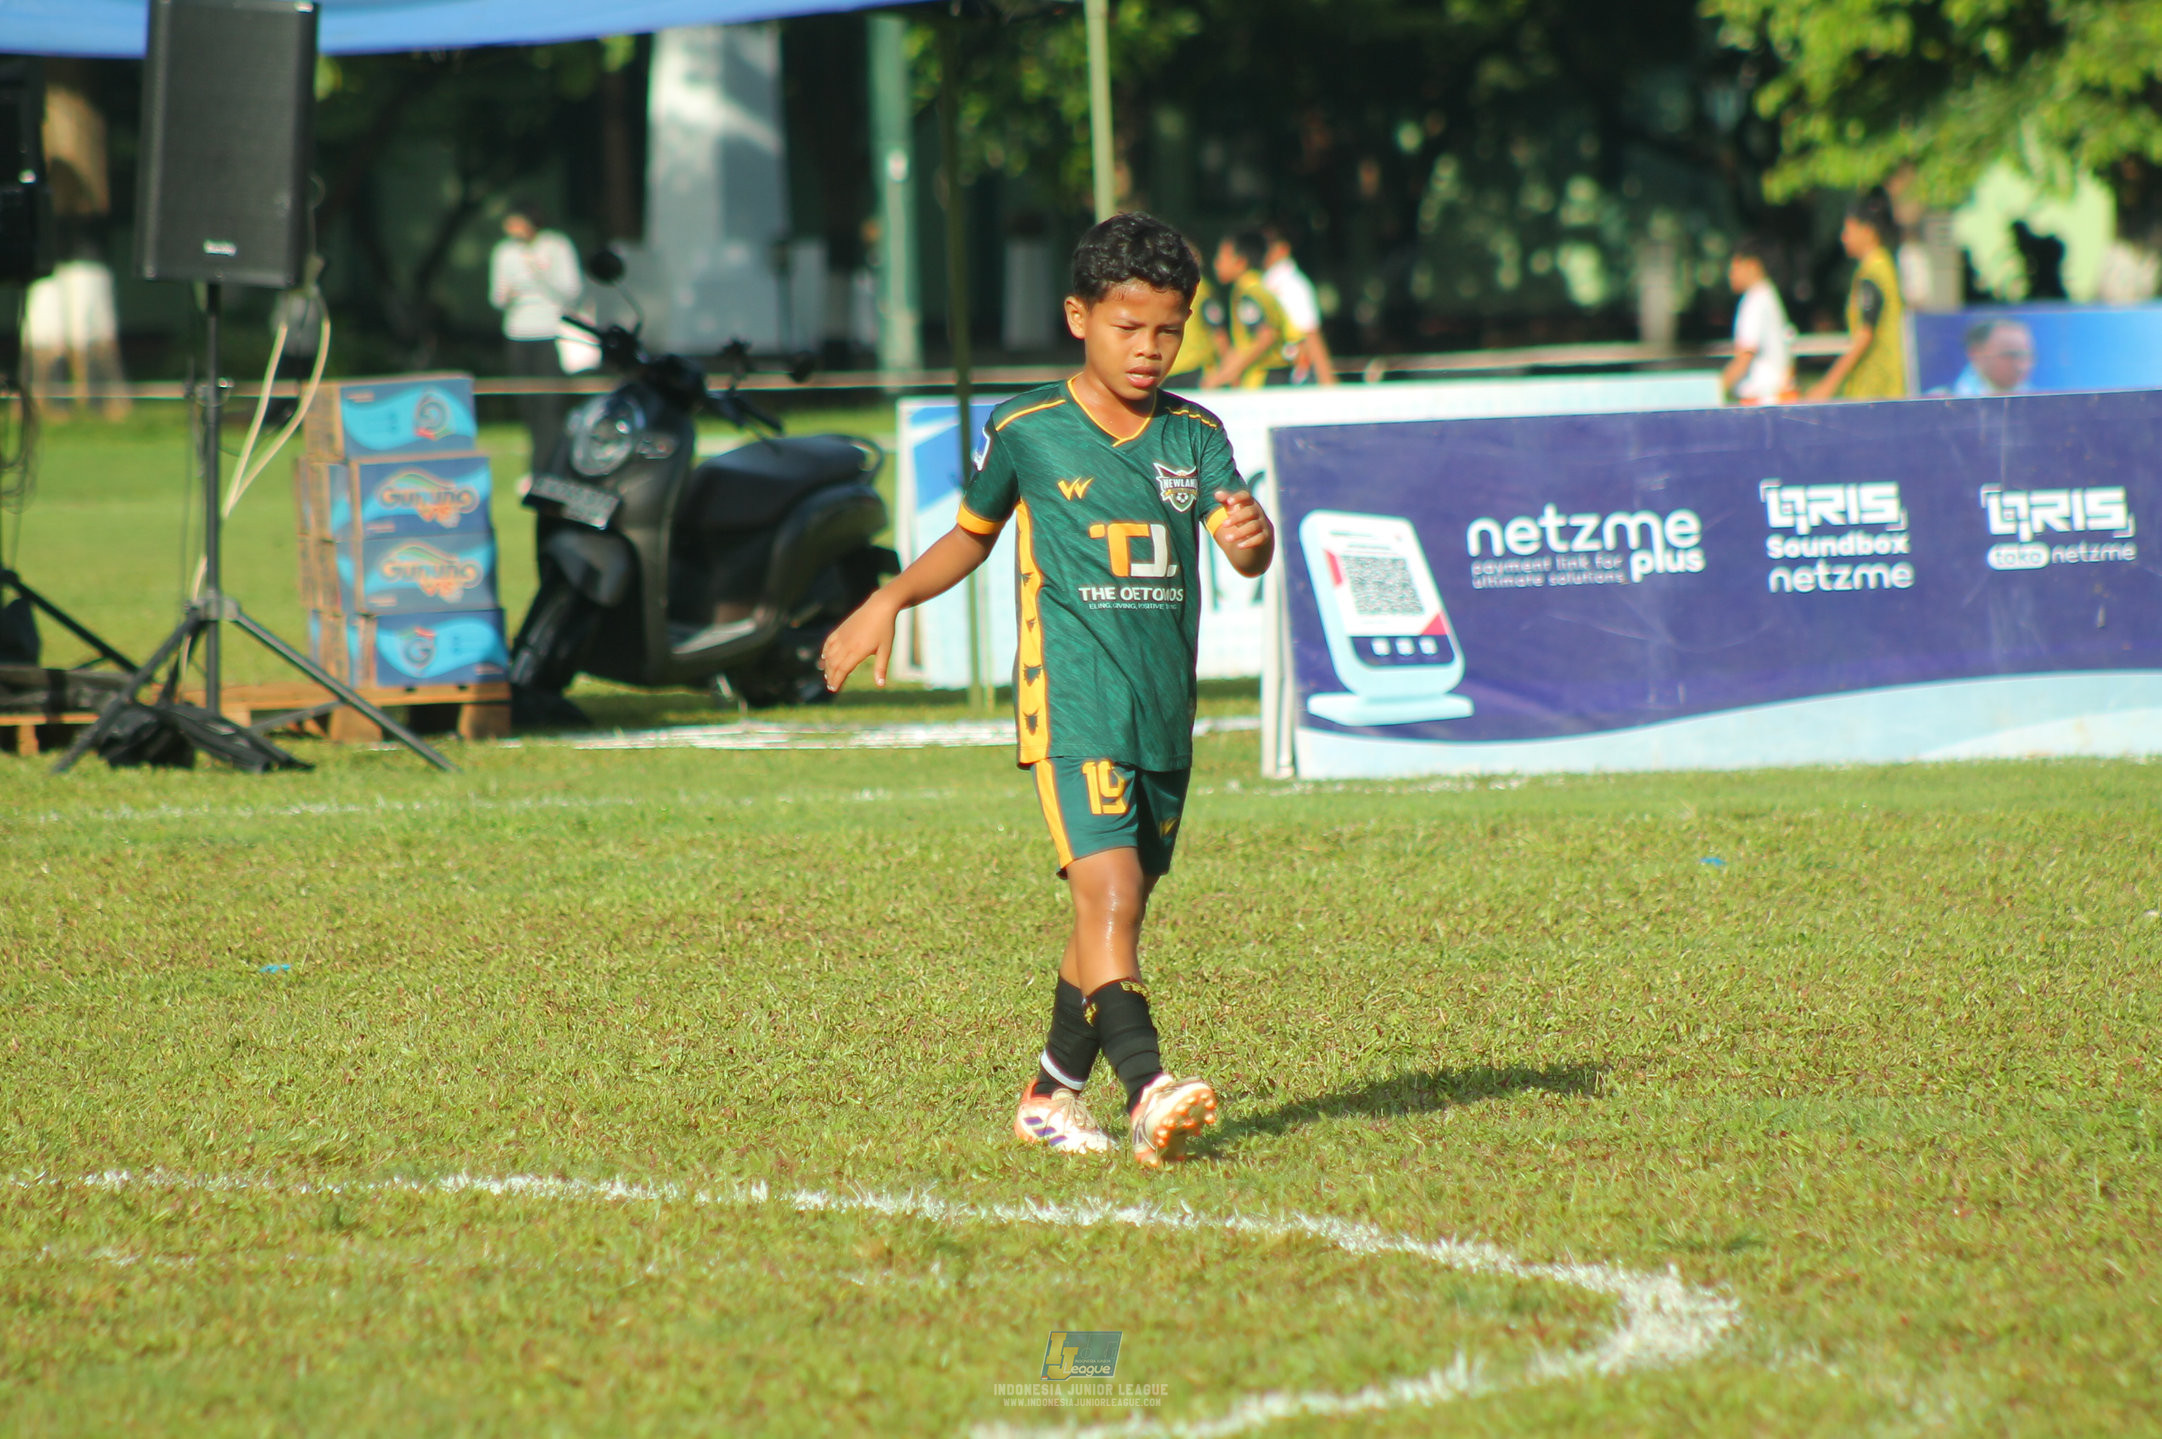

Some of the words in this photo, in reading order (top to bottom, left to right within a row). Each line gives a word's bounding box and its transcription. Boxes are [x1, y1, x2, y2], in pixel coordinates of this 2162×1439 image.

[1163, 478, 1198, 489] NEWLAN
[1763, 480, 1906, 534] QRIS
[1983, 485, 2133, 541] QRIS
[1466, 503, 1701, 557] netzme
[1766, 531, 1911, 560] Soundbox
[2052, 540, 2137, 563] netzme
[1471, 557, 1552, 577] payment
[1556, 553, 1590, 571] link
[1595, 550, 1623, 570] for
[1629, 546, 1706, 583] plus
[1768, 560, 1915, 593] netzme
[1472, 573, 1545, 590] ultimate
[1549, 568, 1627, 587] solutions
[1078, 587, 1116, 601] THE
